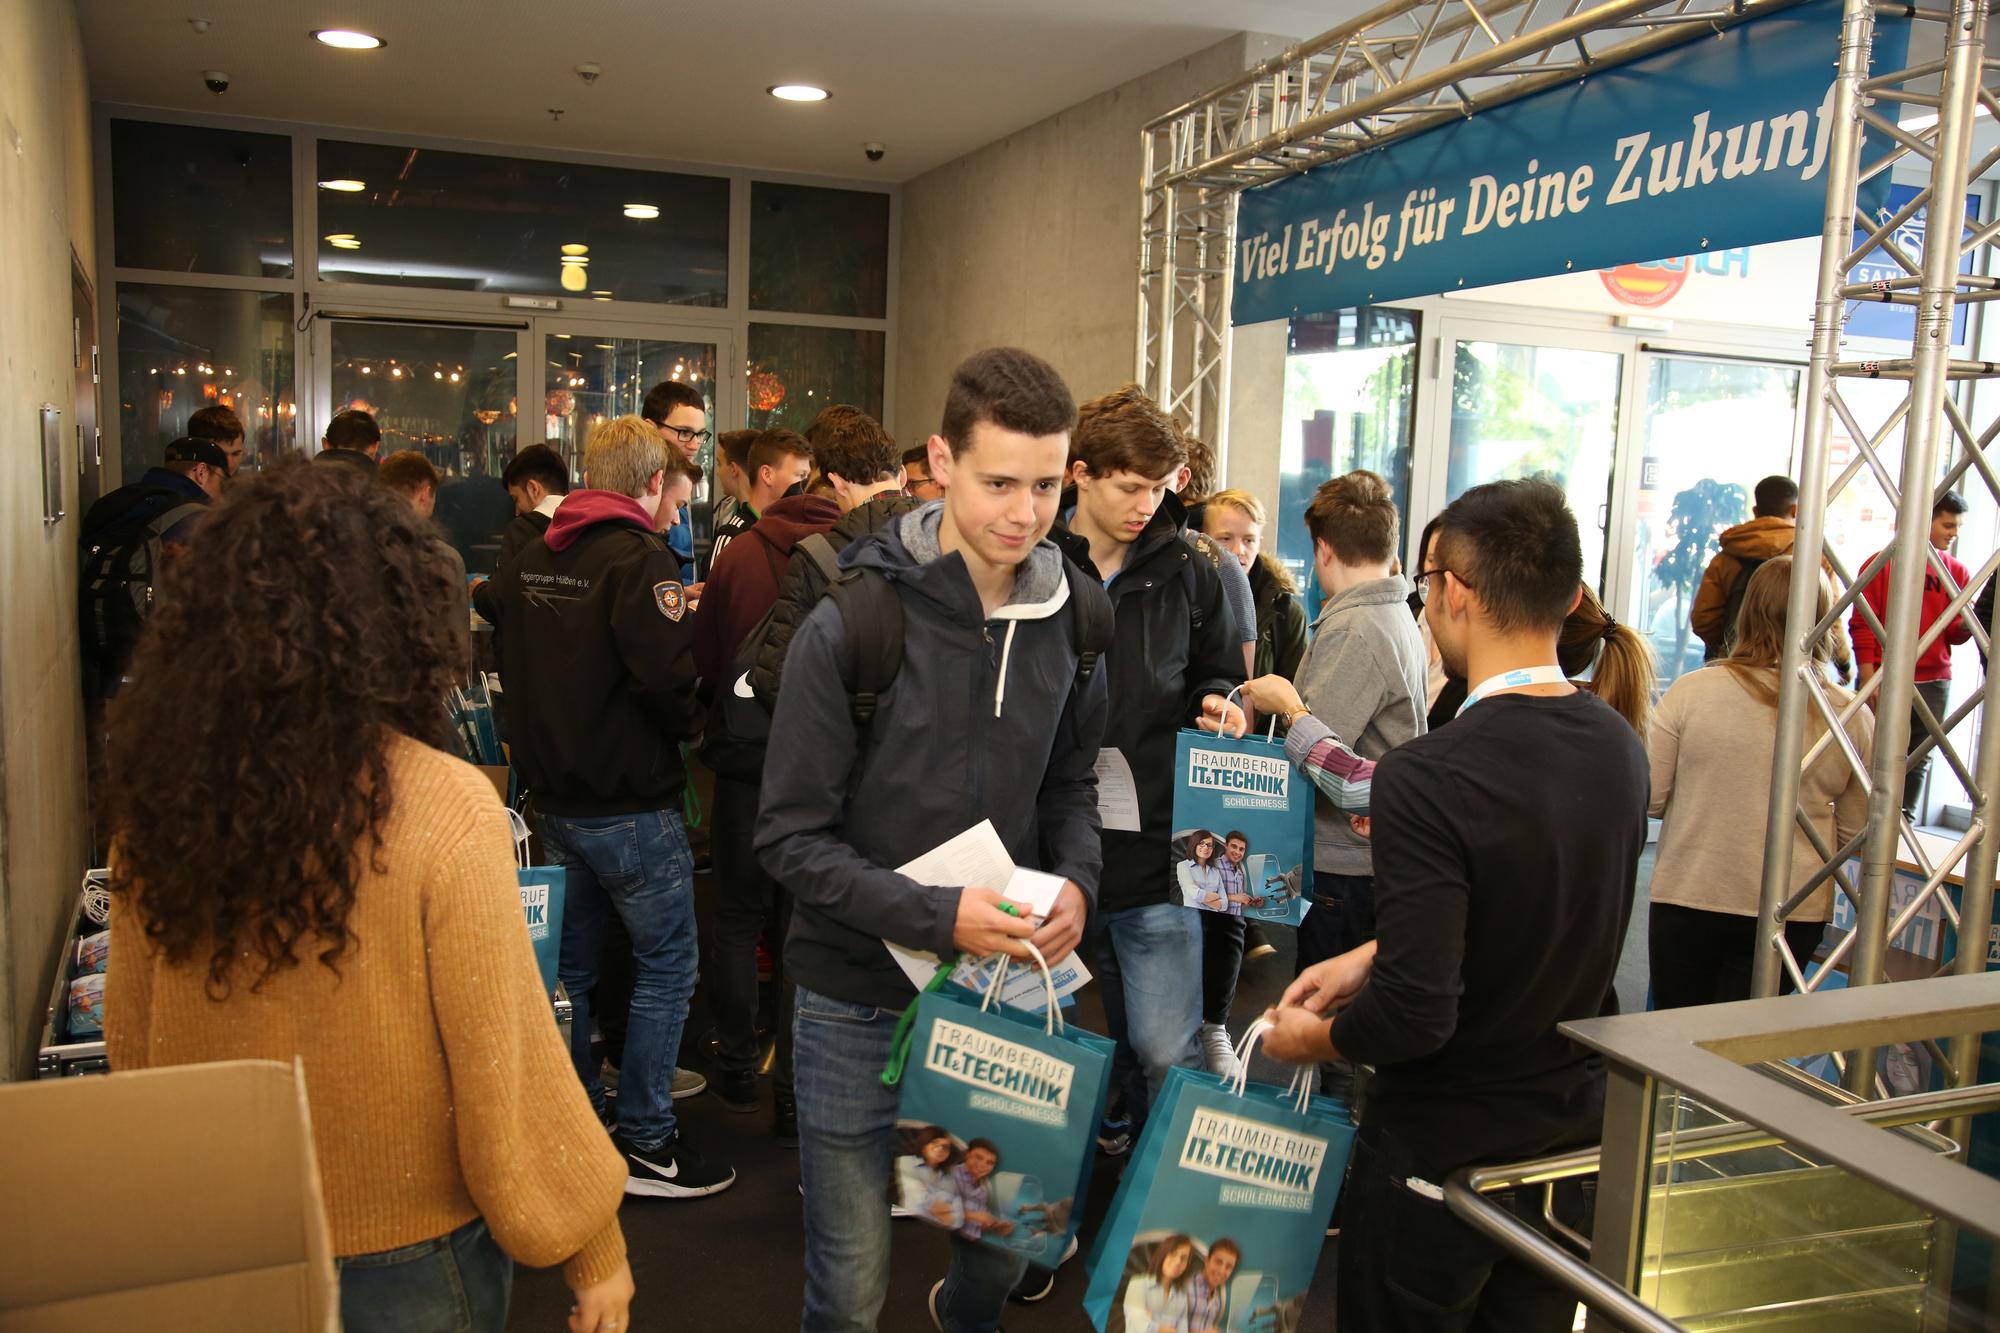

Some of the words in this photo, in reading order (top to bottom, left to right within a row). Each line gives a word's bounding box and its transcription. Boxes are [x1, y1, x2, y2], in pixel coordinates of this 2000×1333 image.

[1242, 231, 1293, 283] Viel
[1295, 201, 1391, 270] Erfolg
[1393, 187, 1455, 262] für
[1461, 158, 1594, 236] Deine
[1606, 79, 1875, 205] Zukunf
[1192, 752, 1286, 776] TRAUMBERUF
[1225, 796, 1288, 809] SCHÜLERMESSE
[938, 1025, 1069, 1081] TRAUMBERUF
[1197, 1116, 1321, 1162] TRAUMBERUF
